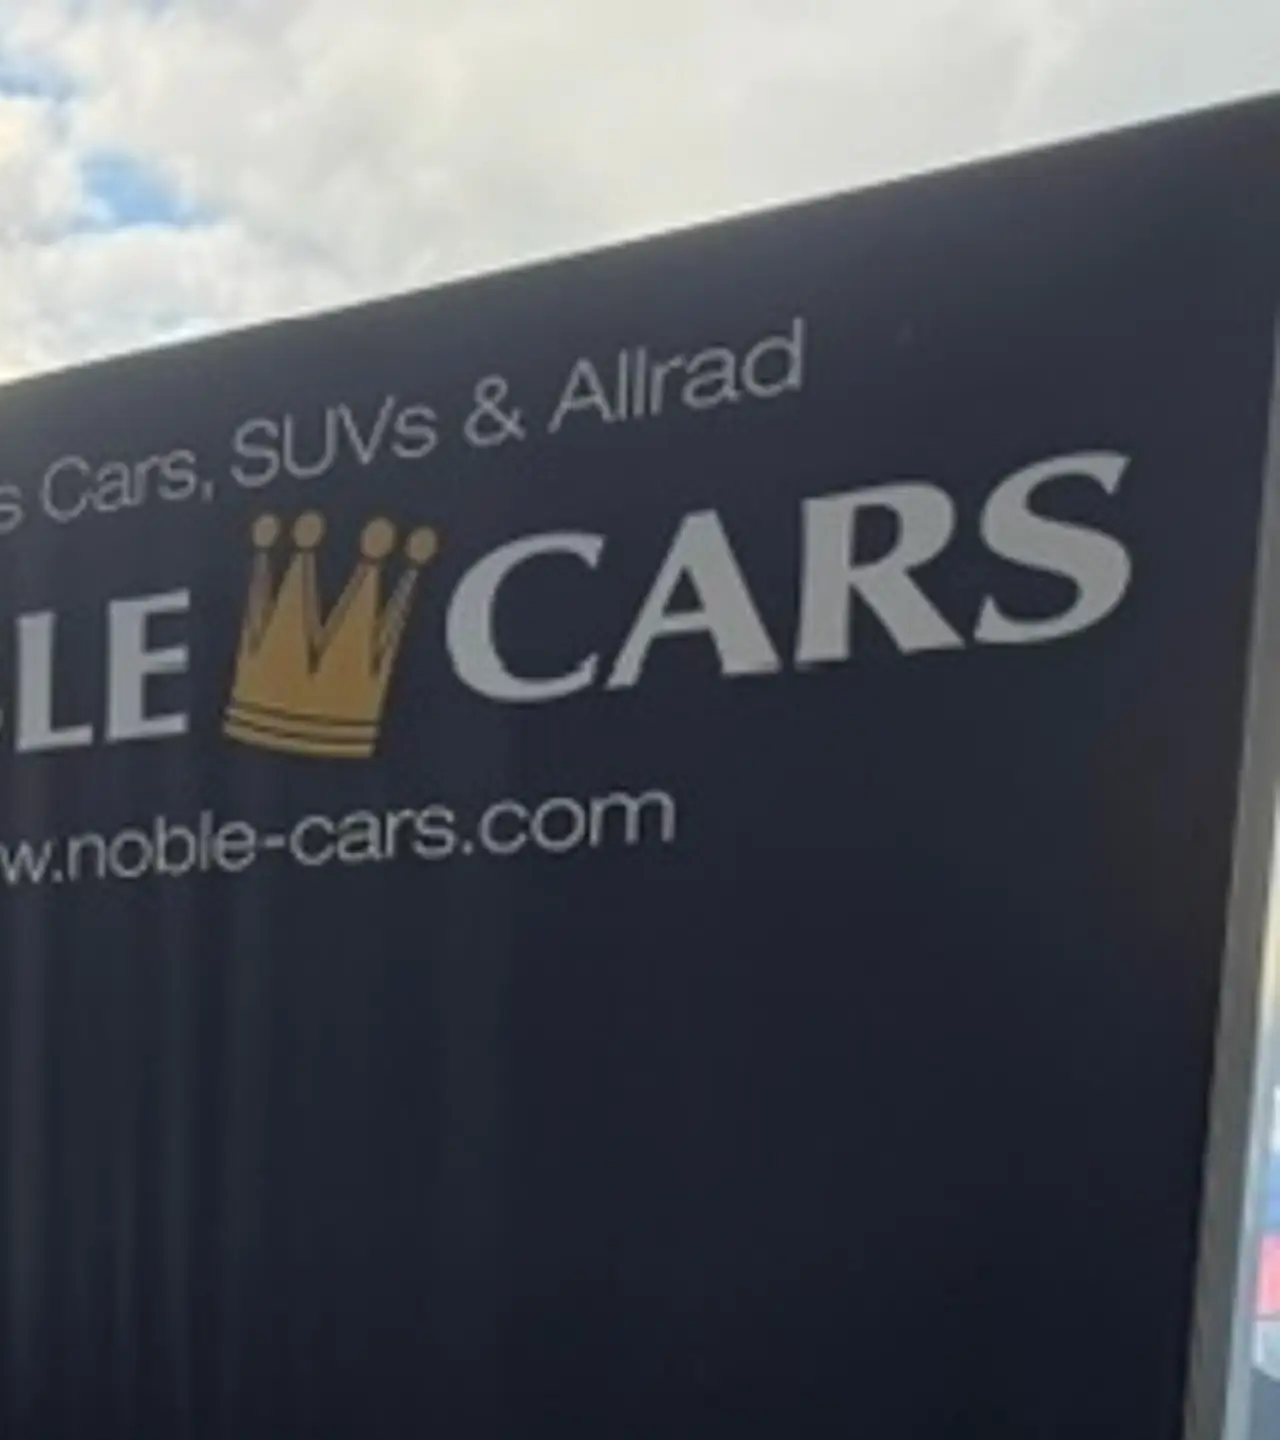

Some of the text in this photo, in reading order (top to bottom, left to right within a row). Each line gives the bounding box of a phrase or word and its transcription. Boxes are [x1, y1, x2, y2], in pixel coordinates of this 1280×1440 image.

[40, 444, 216, 523] Cars,
[230, 396, 439, 489] SUVs
[463, 374, 527, 448] &
[548, 316, 806, 434] Allrad
[444, 449, 1134, 706] CARS
